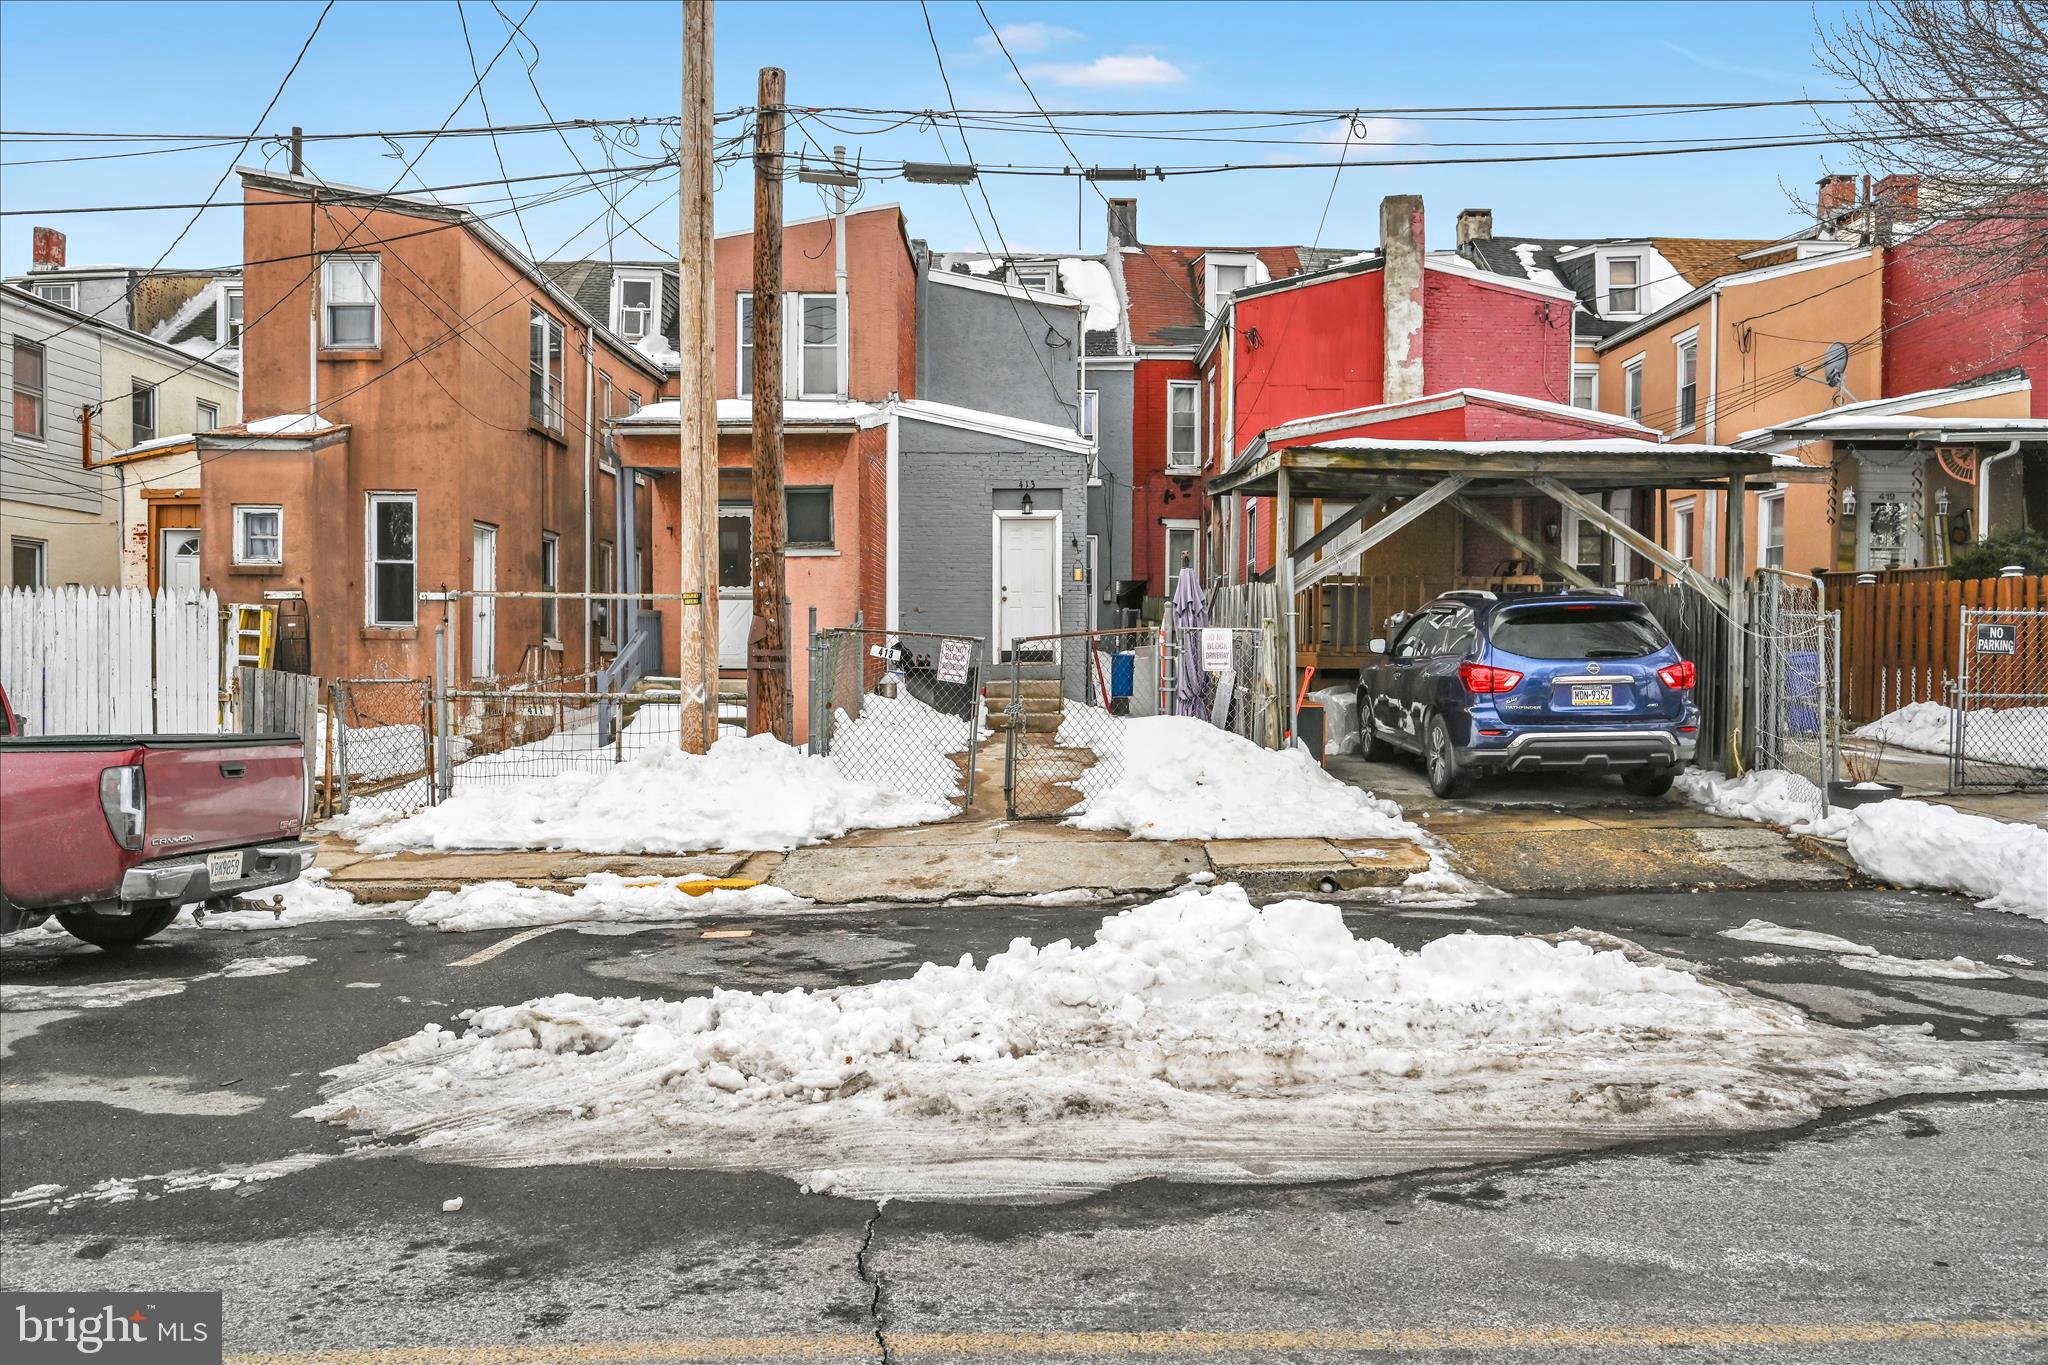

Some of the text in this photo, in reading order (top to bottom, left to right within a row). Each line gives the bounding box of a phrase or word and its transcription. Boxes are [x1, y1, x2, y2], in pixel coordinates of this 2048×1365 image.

[1018, 479, 1036, 489] 413
[1879, 491, 1895, 500] 419
[1990, 626, 2004, 639] NO
[1207, 642, 1228, 650] BLOCK
[1978, 639, 2014, 651] PARKING
[878, 647, 894, 659] 413
[1205, 652, 1230, 660] DRIVEWAY
[151, 834, 195, 847] CANYON
